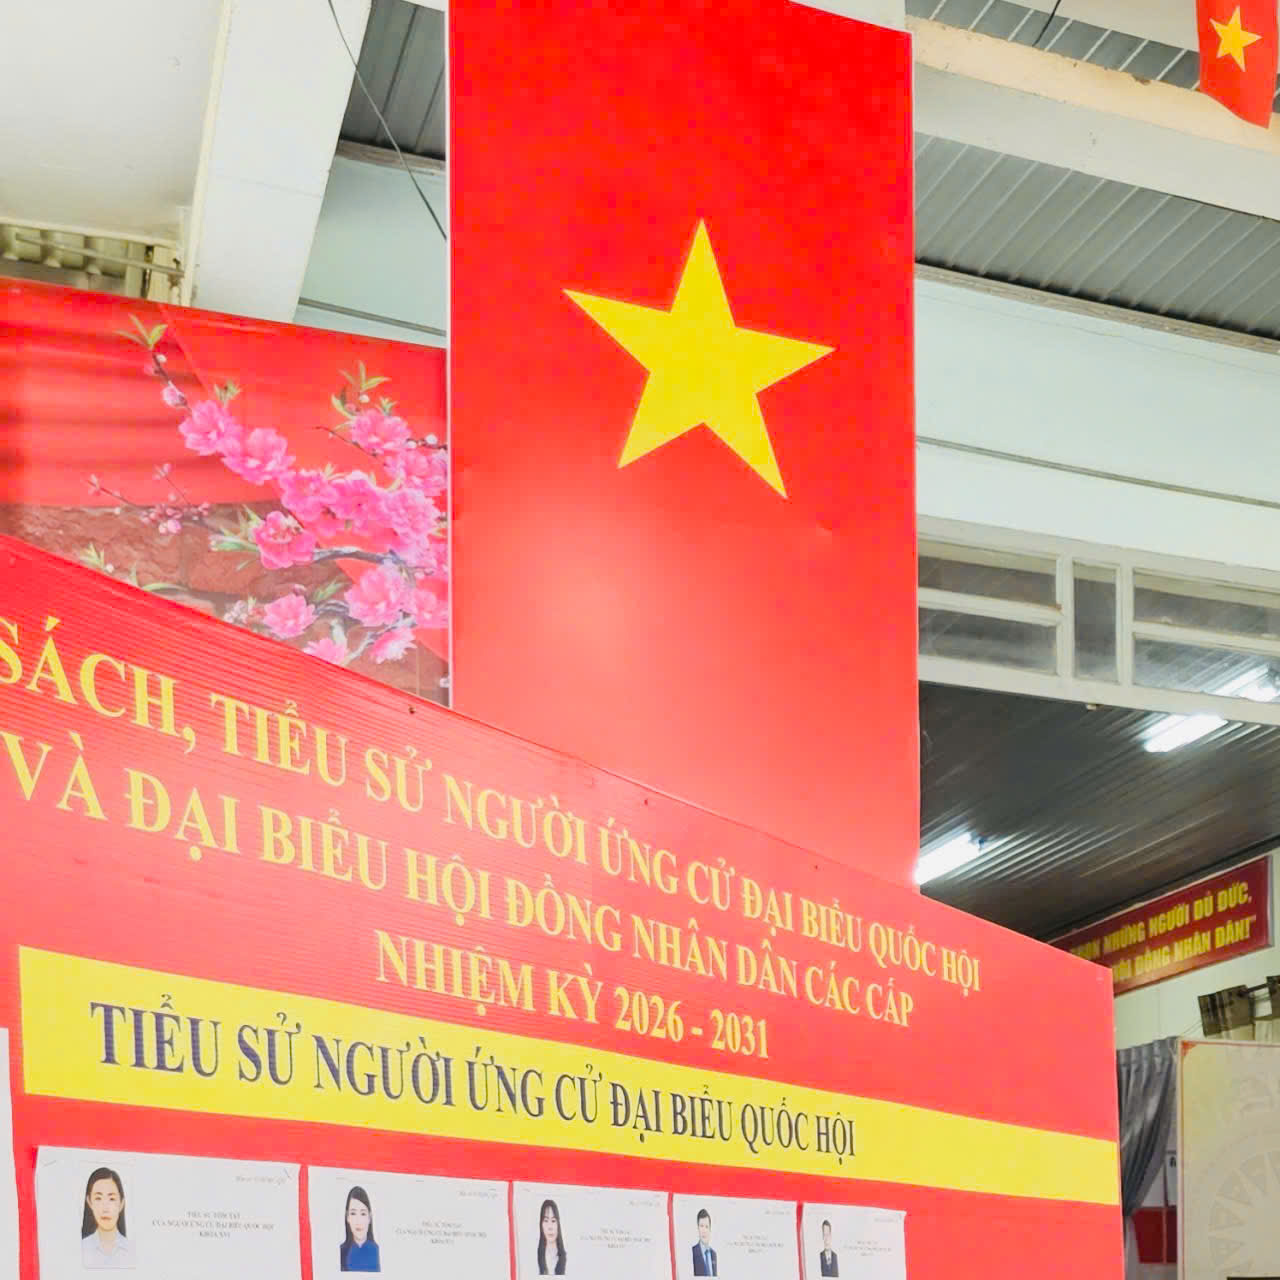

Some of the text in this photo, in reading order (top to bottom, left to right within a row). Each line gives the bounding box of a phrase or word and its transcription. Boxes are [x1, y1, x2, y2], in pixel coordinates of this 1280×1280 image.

[1, 730, 913, 1028] VÀ ĐẠI BIỂU HỘI ĐỒNG NHÂN DÂN CÁC CẤP
[210, 693, 349, 787] TIỂU
[365, 745, 433, 812] SỬ
[444, 773, 588, 865] NGƯỜI
[600, 817, 678, 895] ỨNG
[687, 851, 737, 911] CỬ
[743, 876, 794, 936] ĐẠI
[801, 890, 862, 949] BIỂU
[869, 915, 936, 976] QUỐC
[943, 945, 980, 997] HỘI
[90, 993, 856, 1165] TIỂU SỬ NGƯỜI ỨNG CỬ ĐẠI BIỂU QUỐC HỘI
[375, 930, 768, 1058] NHIỆM KỲ 2026 - 2031
